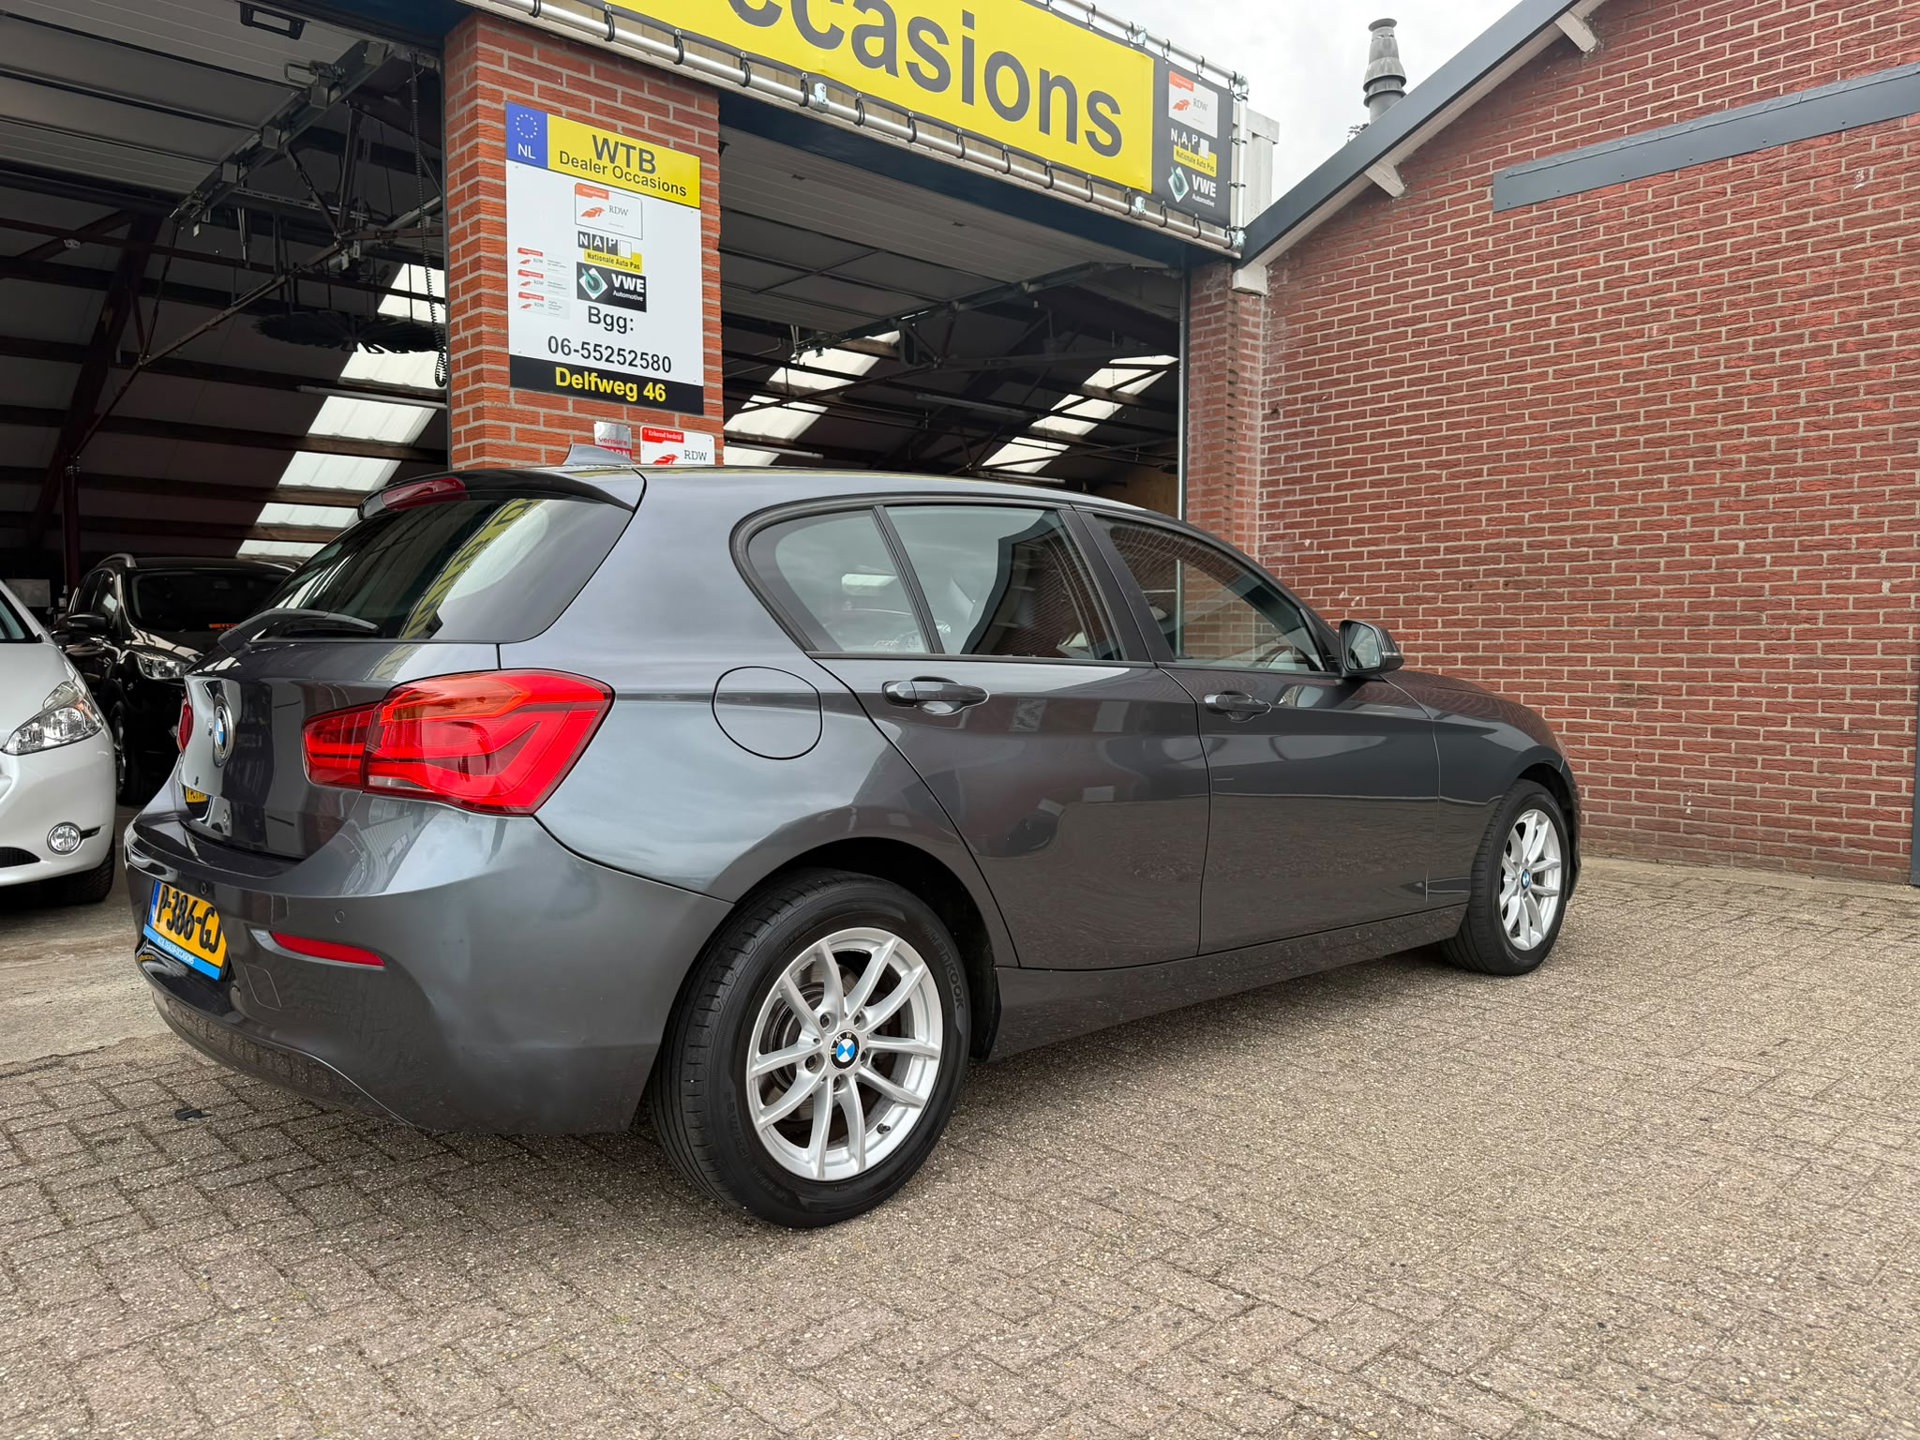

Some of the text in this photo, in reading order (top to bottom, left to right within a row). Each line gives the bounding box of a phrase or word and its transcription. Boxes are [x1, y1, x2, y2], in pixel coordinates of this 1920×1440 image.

[517, 143, 537, 160] NL
[592, 134, 657, 175] WTB
[559, 150, 688, 197] Dealer Occasions
[1191, 174, 1217, 198] VWE
[608, 205, 629, 217] RDW
[587, 252, 641, 270] Nationale Auto Pas
[611, 273, 646, 293] VWE
[612, 290, 645, 302] Automotive
[588, 305, 634, 335] Bgg:
[547, 335, 672, 374] 06-55252580
[555, 366, 667, 402] Delfweg 46
[684, 450, 708, 461] RDW
